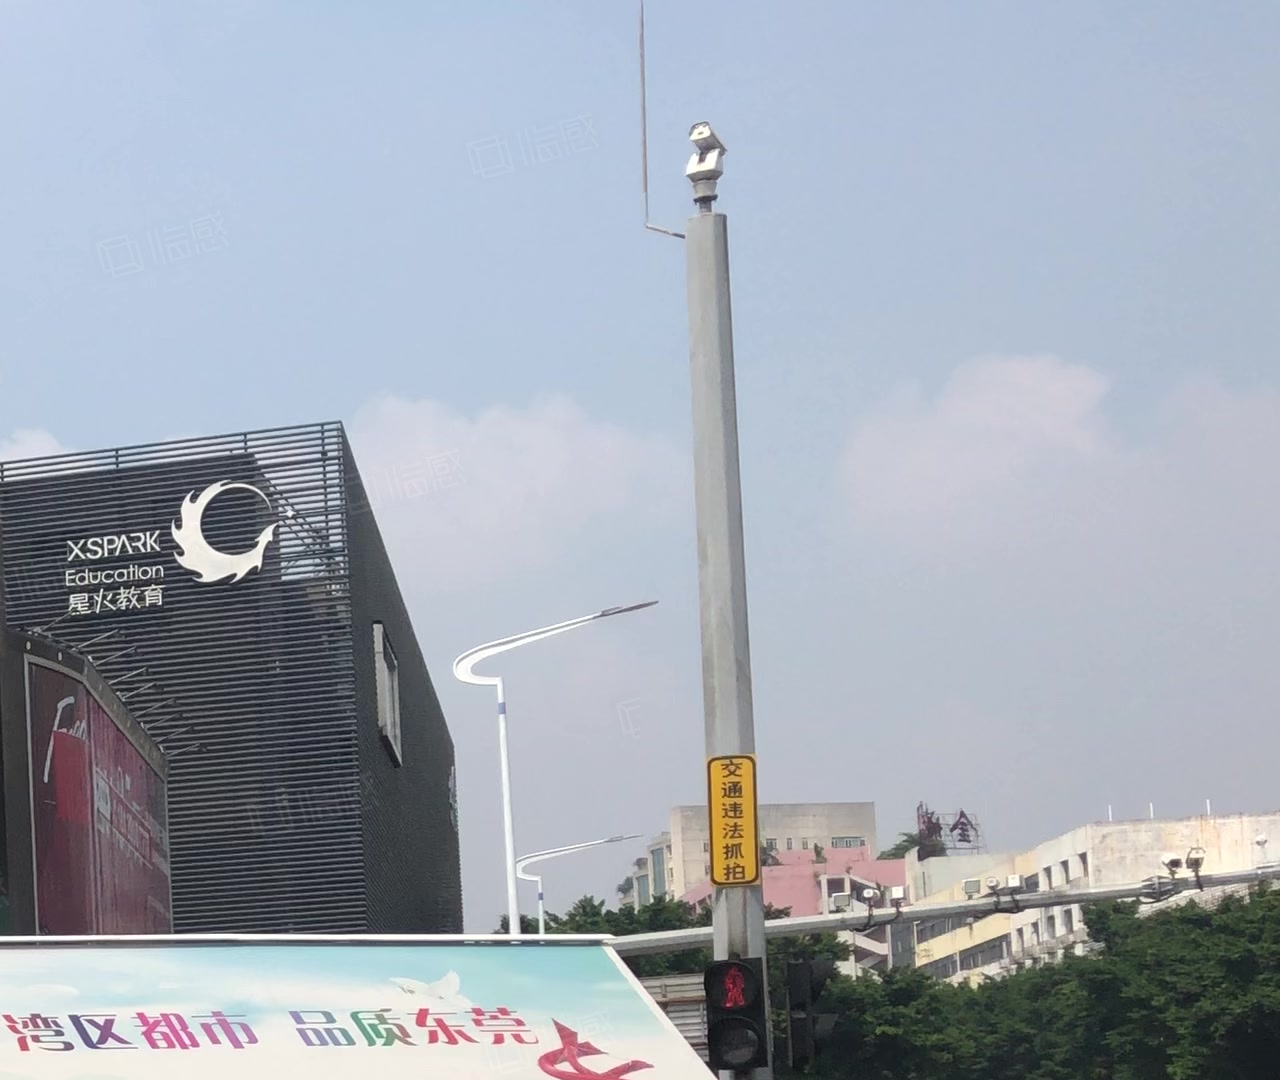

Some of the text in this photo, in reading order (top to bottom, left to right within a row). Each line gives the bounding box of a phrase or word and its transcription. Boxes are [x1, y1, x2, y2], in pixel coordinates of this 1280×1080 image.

[67, 530, 162, 562] XSPARK
[65, 563, 165, 587] Education
[68, 585, 165, 616] 星火教育
[721, 759, 746, 881] 交通违法抓拍
[2, 1007, 539, 1052] 湾区都市 品质东莞
